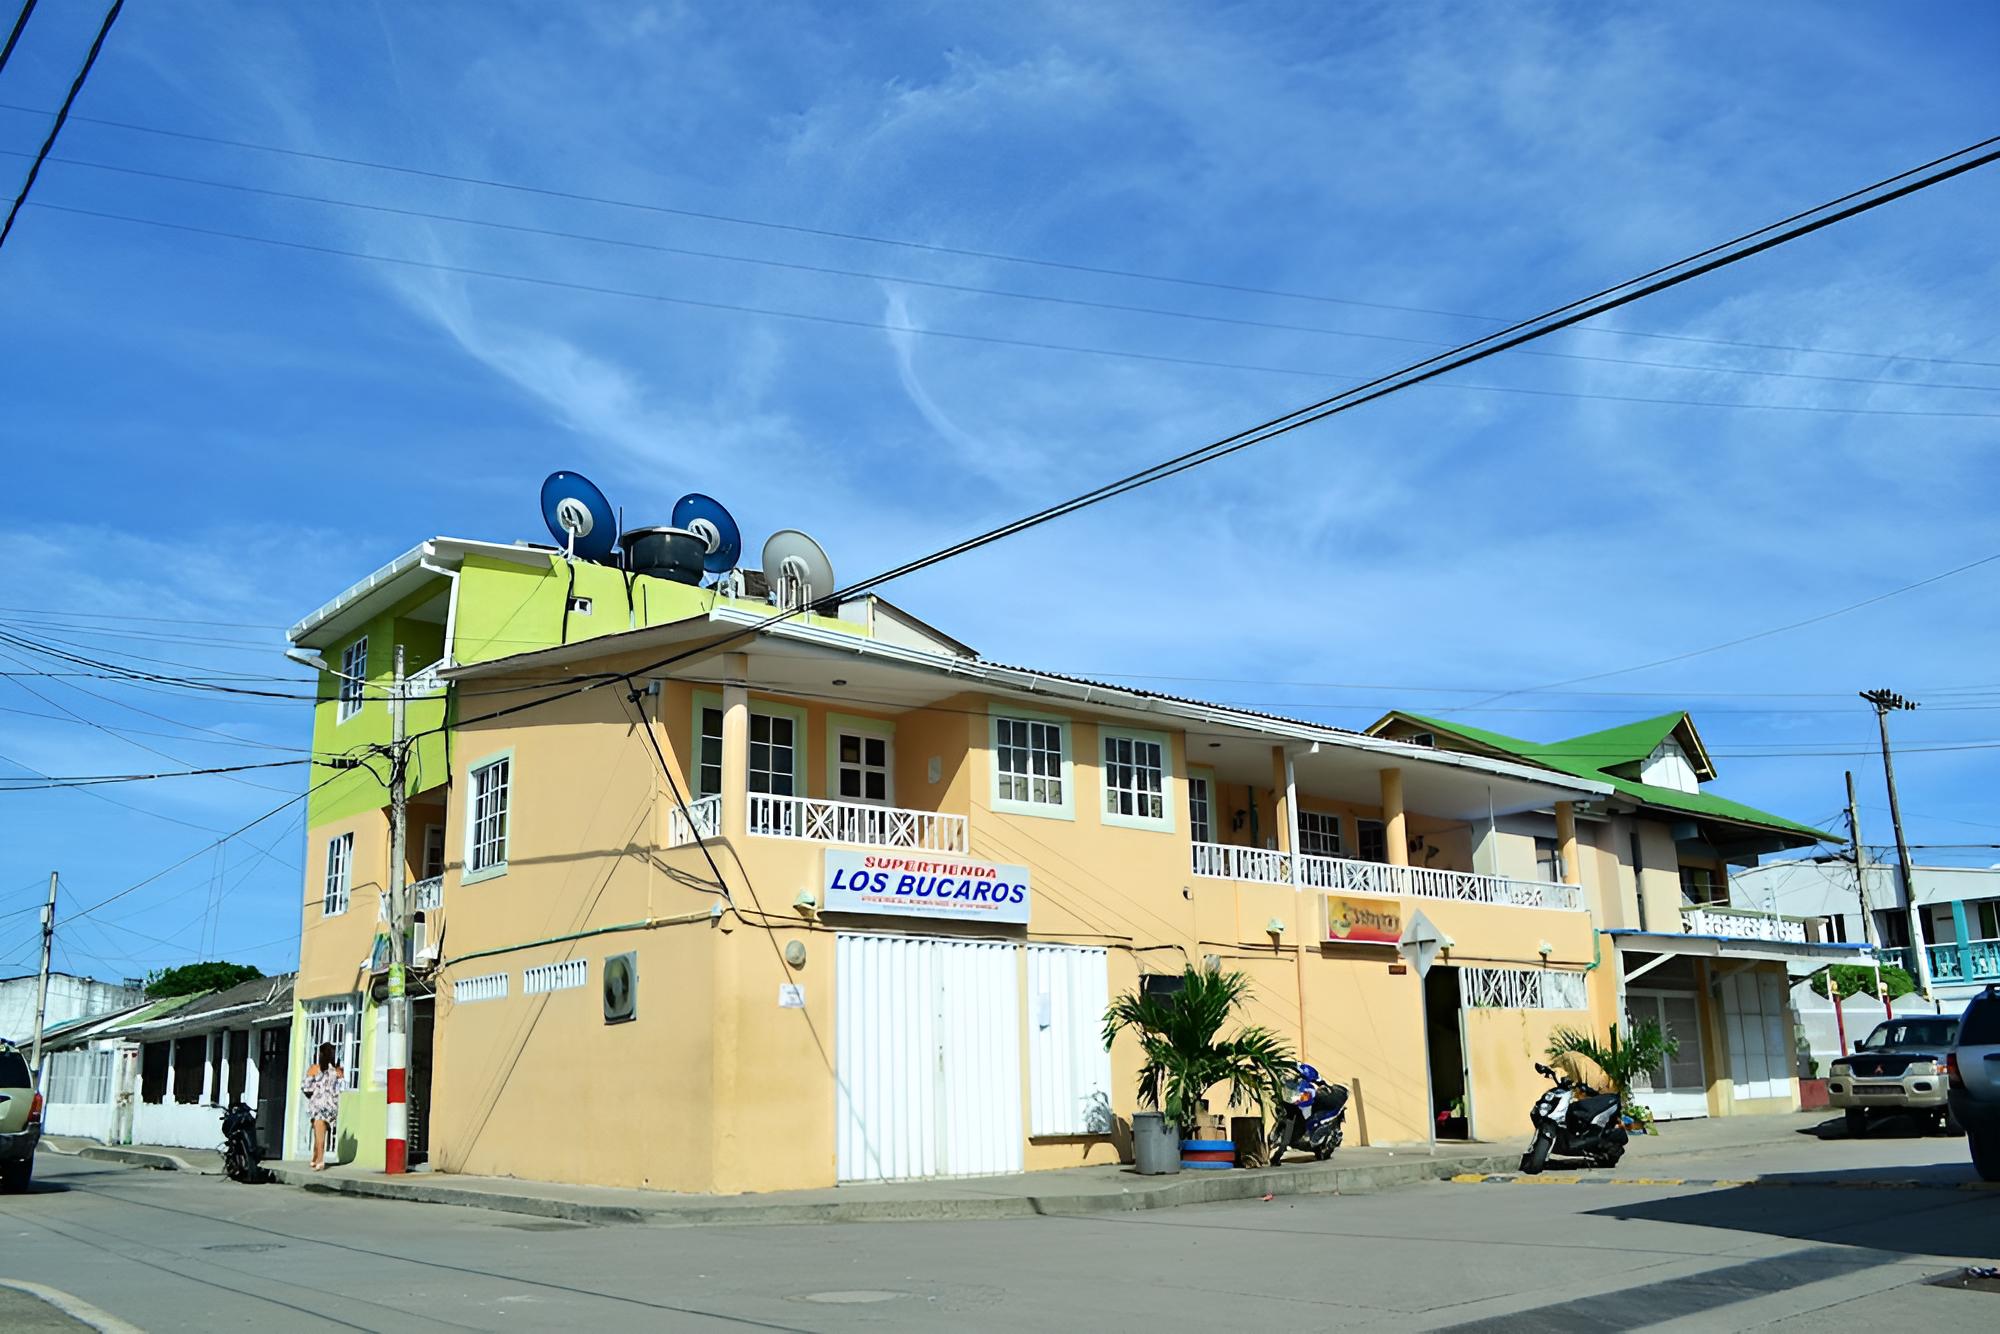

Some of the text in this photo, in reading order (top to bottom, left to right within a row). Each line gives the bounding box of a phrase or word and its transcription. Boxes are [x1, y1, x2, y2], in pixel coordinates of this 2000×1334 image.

[864, 856, 997, 879] SUPERTIENDA
[830, 869, 889, 893] LOS
[896, 875, 1026, 903] BUCAROS
